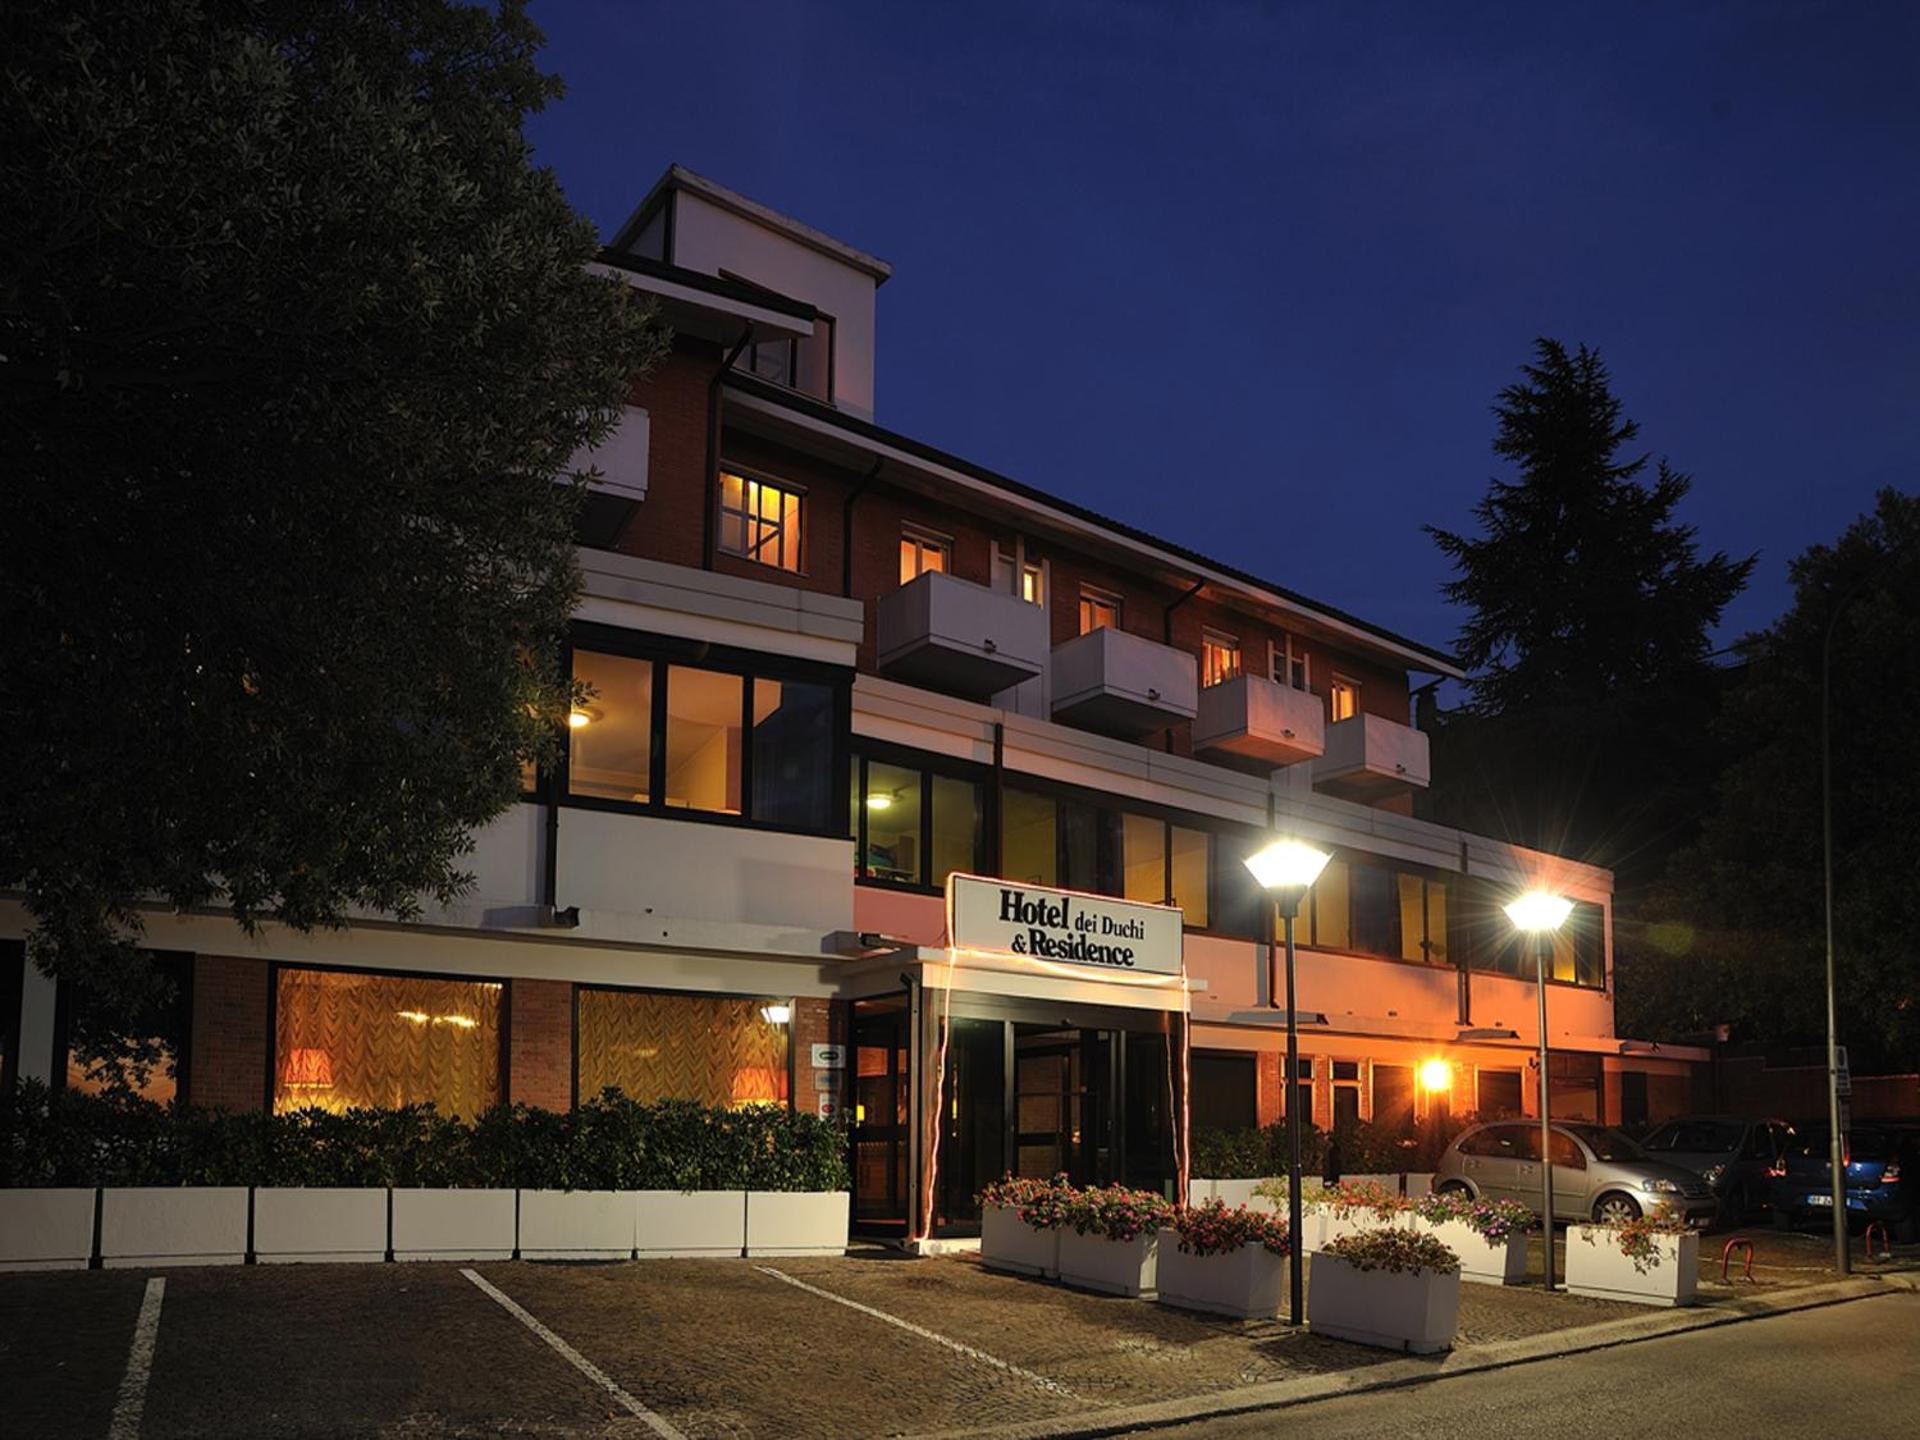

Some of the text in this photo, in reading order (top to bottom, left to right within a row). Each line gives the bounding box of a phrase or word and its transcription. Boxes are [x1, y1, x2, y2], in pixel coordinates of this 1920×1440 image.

[999, 889, 1145, 940] Hotel dei Duchi
[1028, 928, 1135, 966] Residence
